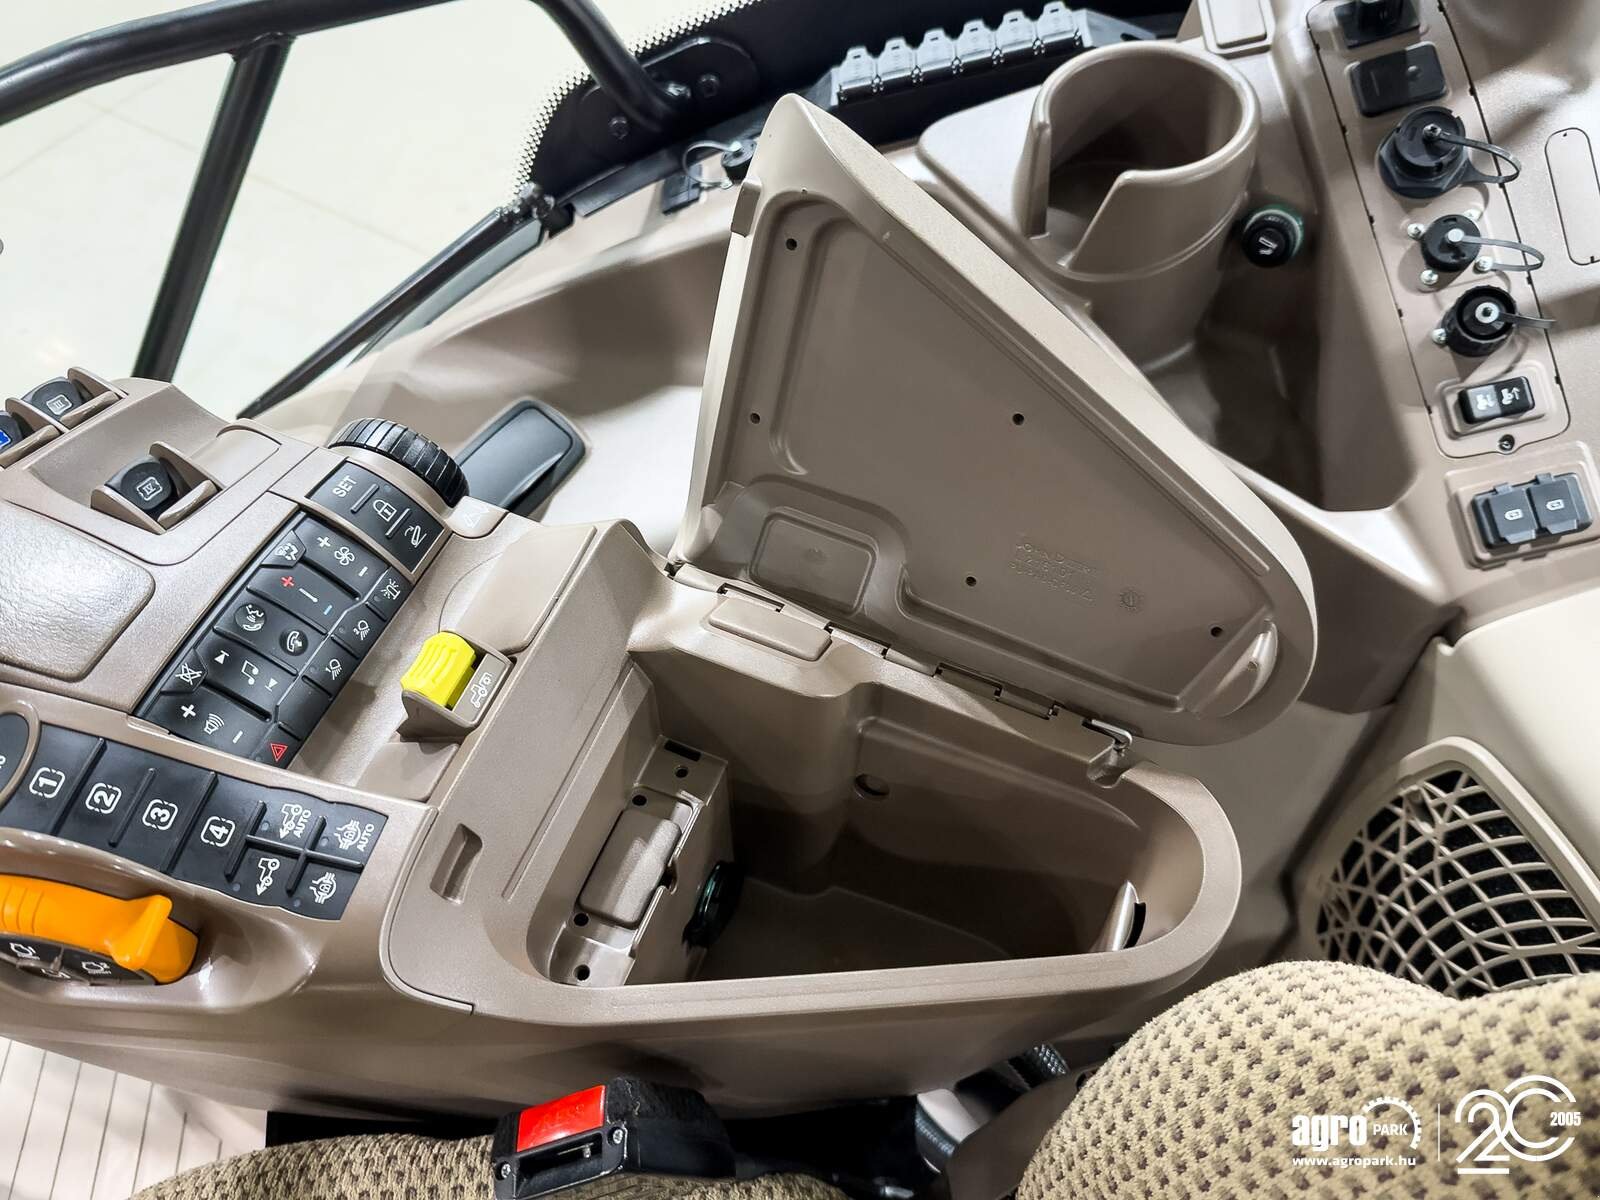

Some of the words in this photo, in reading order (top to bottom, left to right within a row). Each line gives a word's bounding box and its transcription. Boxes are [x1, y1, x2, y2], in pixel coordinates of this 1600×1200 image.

[332, 475, 357, 498] SET
[38, 776, 58, 788] 1
[93, 790, 116, 808] 2
[150, 807, 171, 823] 3
[292, 809, 312, 839] AUTO
[208, 823, 229, 840] 4
[356, 823, 375, 852] AUTO
